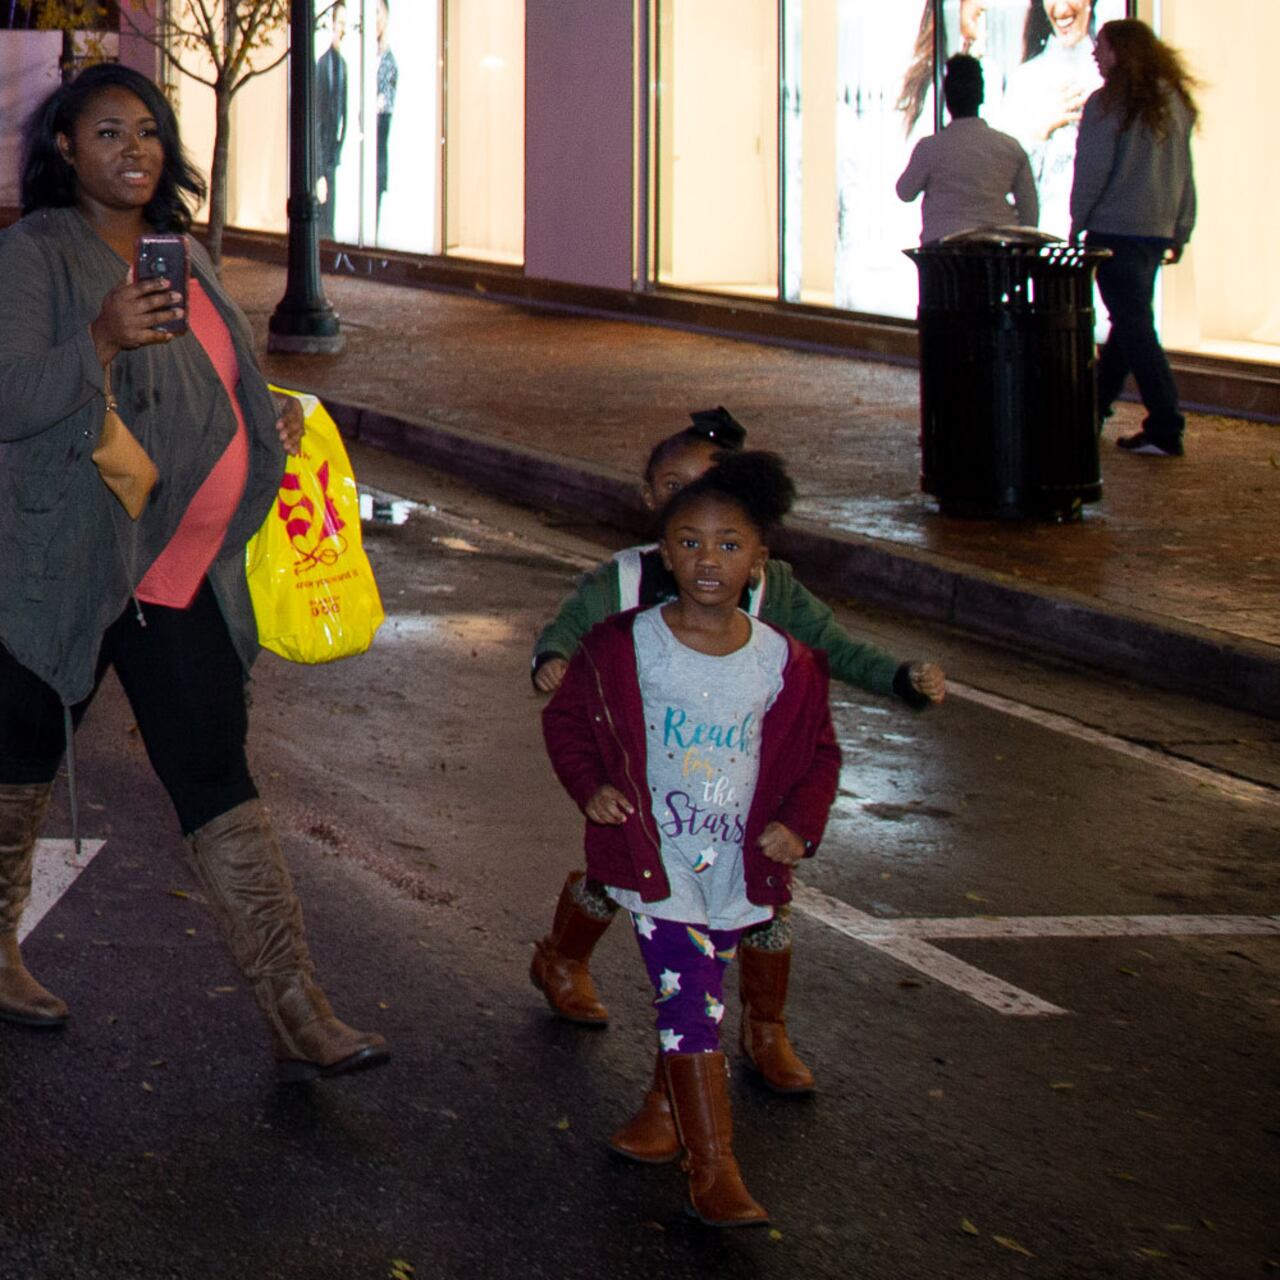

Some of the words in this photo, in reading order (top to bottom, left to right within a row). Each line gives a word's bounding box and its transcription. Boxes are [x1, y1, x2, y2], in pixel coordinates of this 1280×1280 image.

[663, 705, 754, 756] Reach
[682, 746, 714, 780] for
[700, 776, 737, 806] the
[660, 790, 746, 844] Stars
